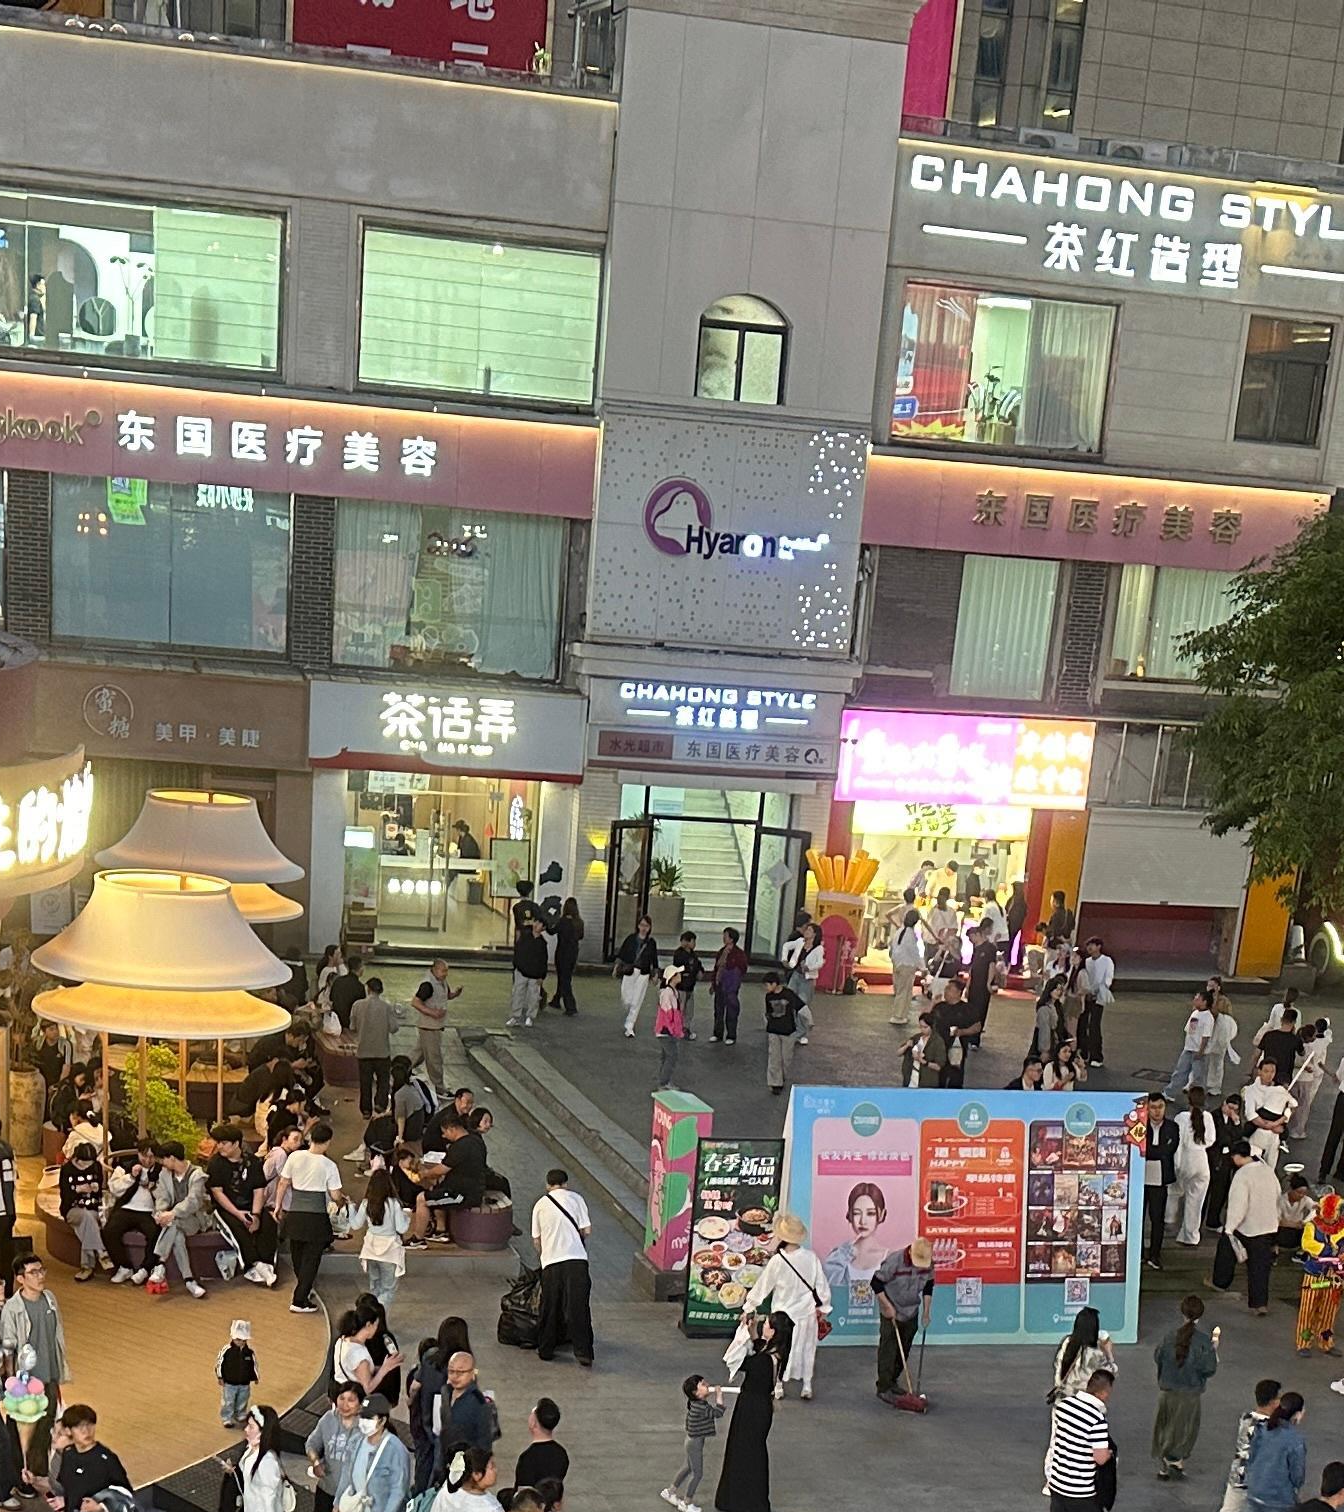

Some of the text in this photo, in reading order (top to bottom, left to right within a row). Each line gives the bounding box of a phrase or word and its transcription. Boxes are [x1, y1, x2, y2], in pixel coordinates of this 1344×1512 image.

[911, 155, 1195, 222] CHAHONG
[1043, 223, 1243, 289] 茶红造型
[117, 409, 438, 478] 东国医疗美容
[686, 524, 776, 559] Hyaron
[973, 490, 1243, 543] 东国医疗美容
[379, 692, 518, 744] 茶话弄
[620, 682, 817, 709] CHAHONG STYLE
[686, 740, 800, 762] 东国医疗美容
[705, 1152, 775, 1176] 春季新品
